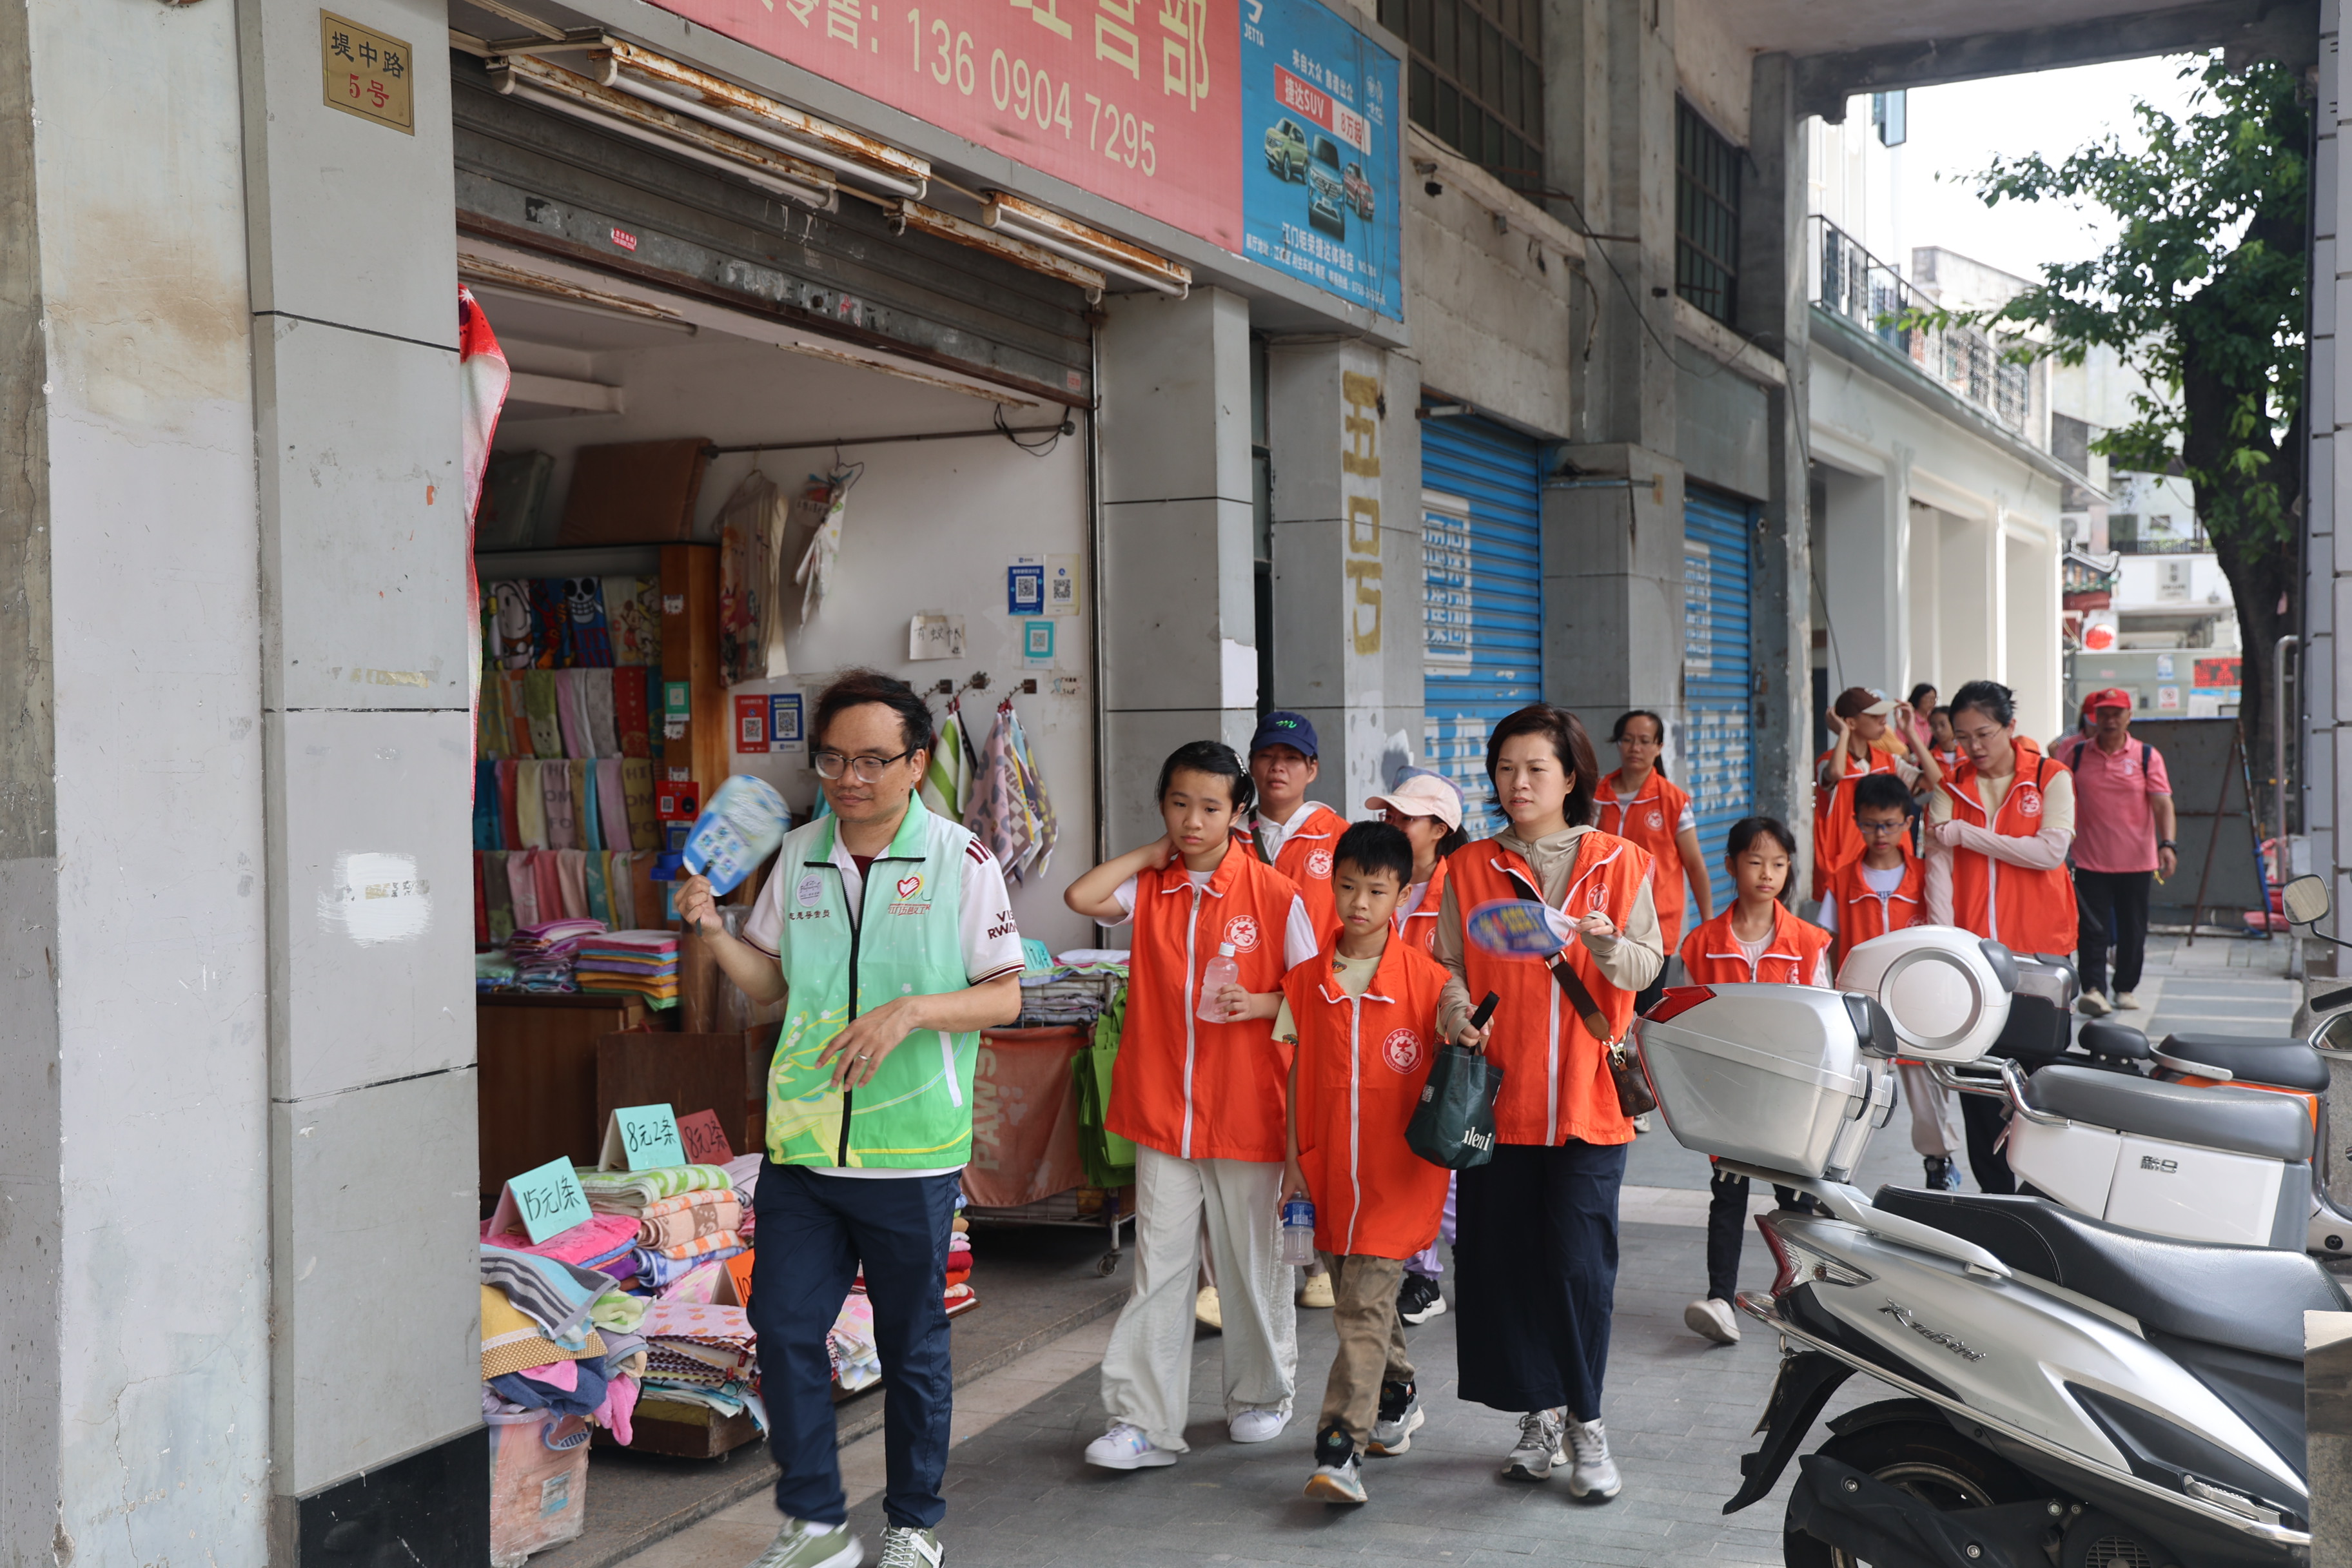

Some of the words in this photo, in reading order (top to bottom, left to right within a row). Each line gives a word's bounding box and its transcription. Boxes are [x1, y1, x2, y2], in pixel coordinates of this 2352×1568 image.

[331, 30, 404, 79] 堤中路
[1244, 23, 1264, 48] JETTA
[349, 73, 389, 108] 5号
[907, 8, 975, 96] 136
[990, 48, 1073, 140] 0904
[1085, 92, 1157, 178] 7295
[1285, 75, 1324, 119] 捷达SUV
[626, 1115, 677, 1153] 8元2条
[683, 1117, 728, 1159] 8元2条
[522, 1175, 582, 1222] 15元1条
